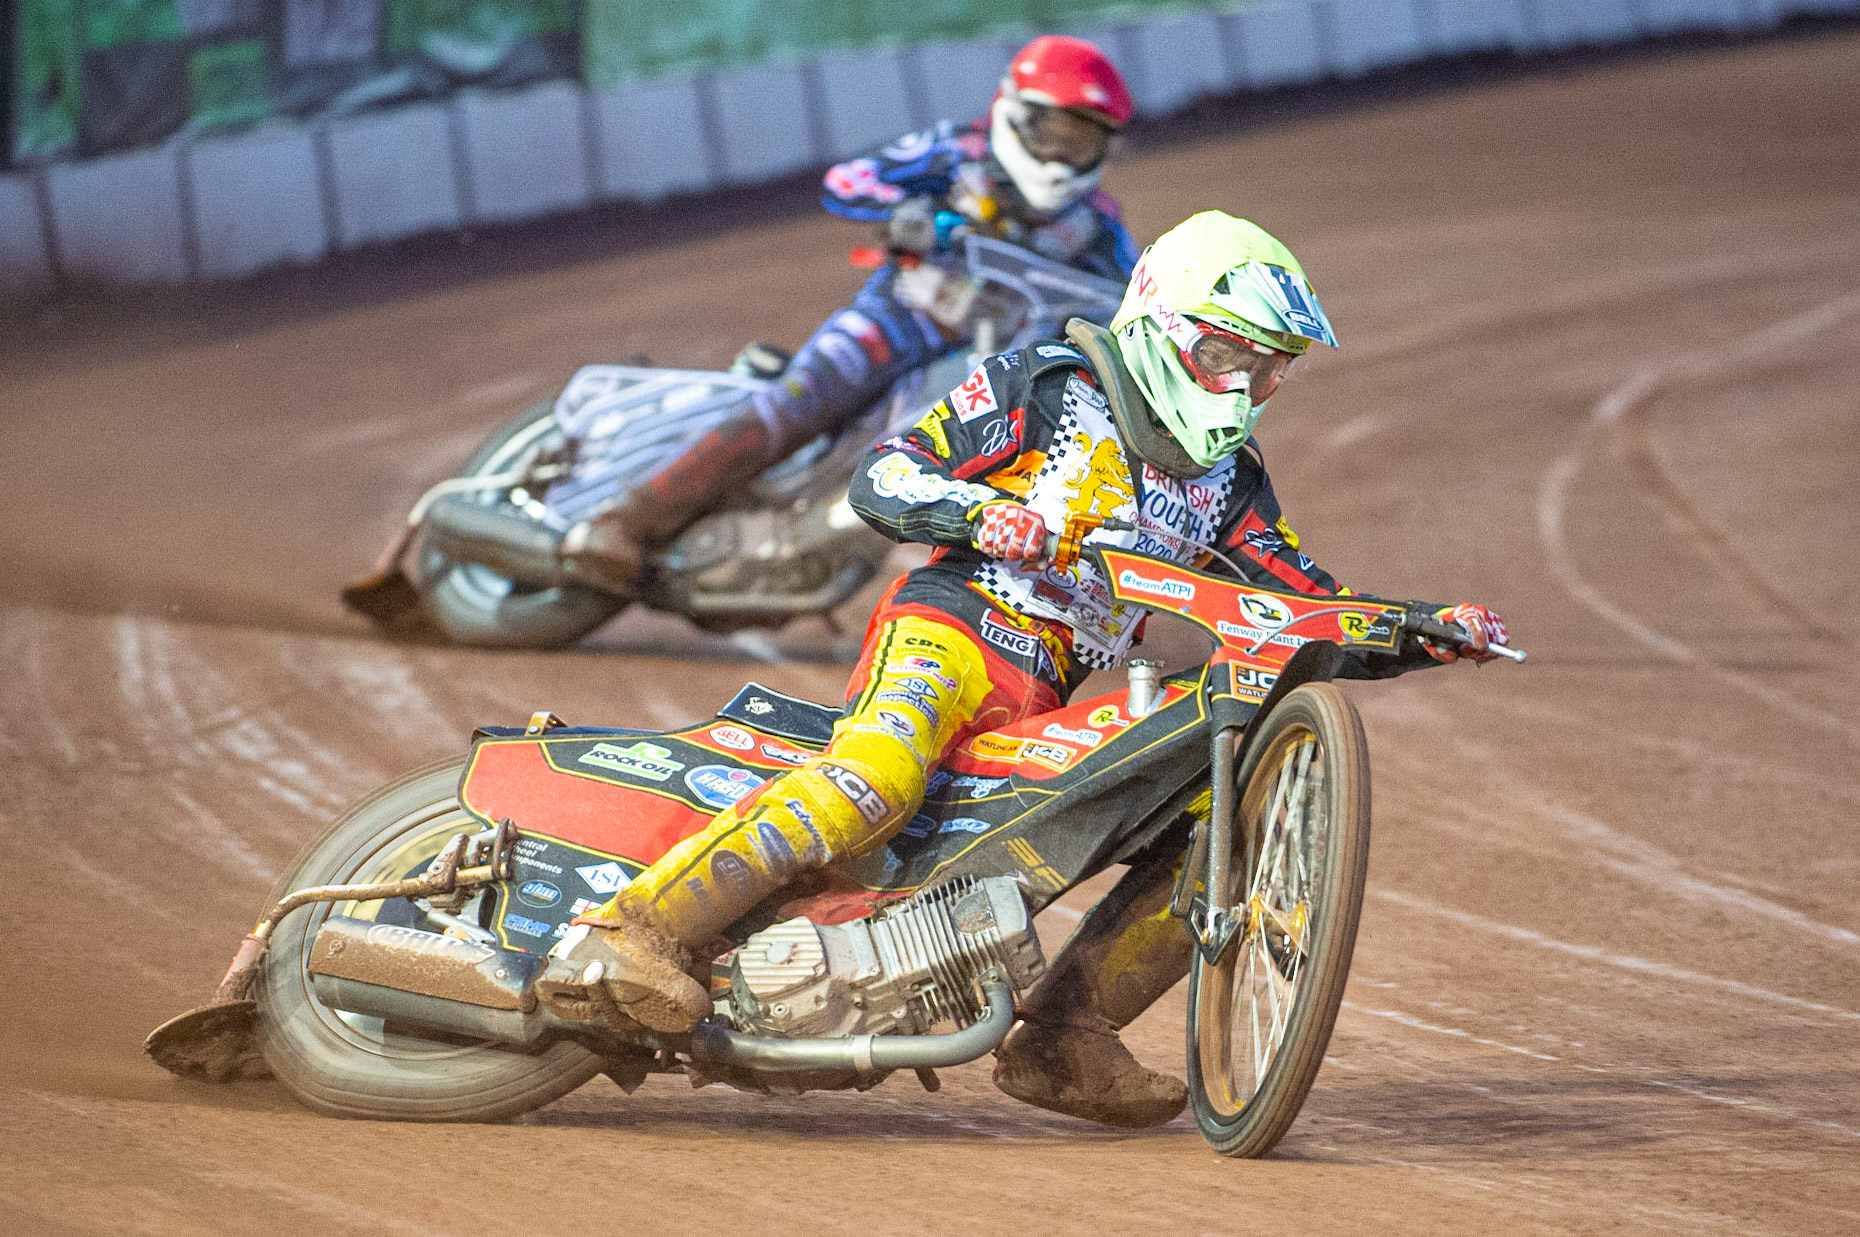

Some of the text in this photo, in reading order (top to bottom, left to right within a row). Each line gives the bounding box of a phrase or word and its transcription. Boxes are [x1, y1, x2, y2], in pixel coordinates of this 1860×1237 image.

[961, 370, 992, 412] GK
[1144, 465, 1216, 515] BRITSH
[1123, 573, 1192, 598] #teamATPI
[1220, 622, 1263, 641] Fenway
[1237, 670, 1280, 688] JC
[717, 728, 748, 747] BELL
[588, 750, 671, 775] ROCK OIL
[1022, 744, 1069, 764] JCB
[693, 772, 754, 800] HAGO
